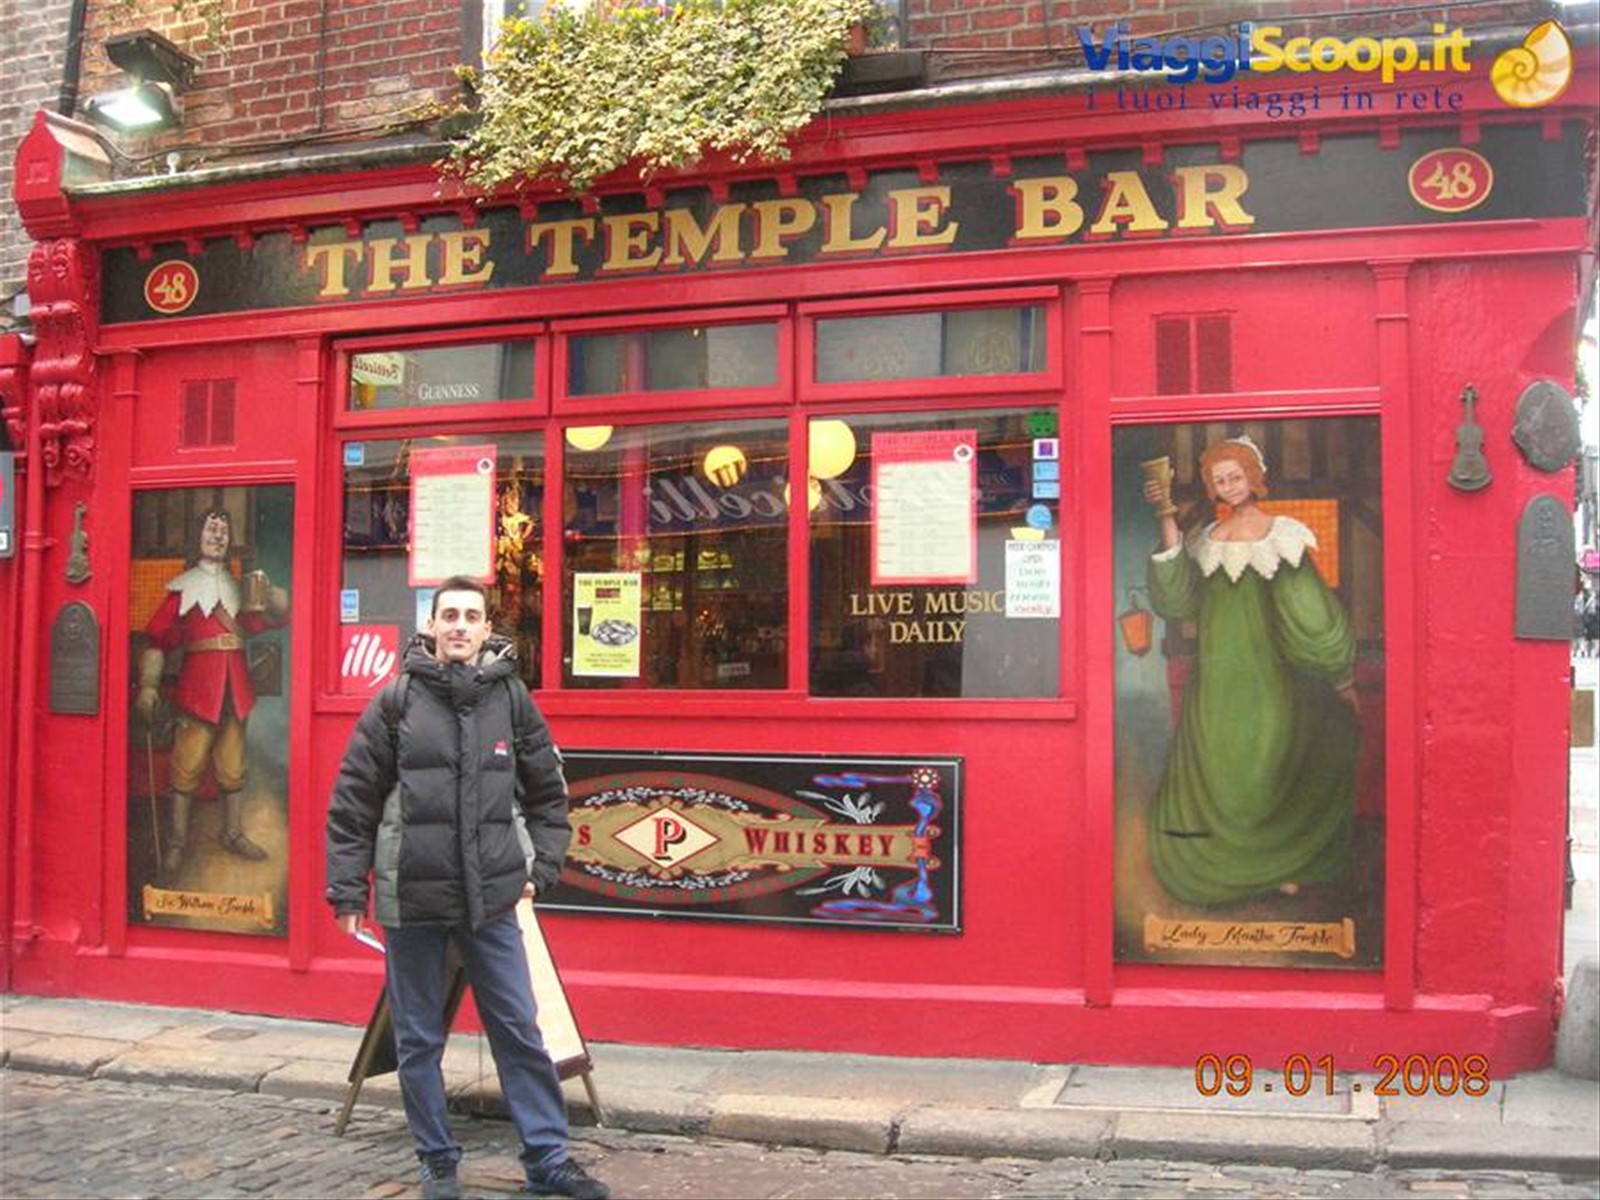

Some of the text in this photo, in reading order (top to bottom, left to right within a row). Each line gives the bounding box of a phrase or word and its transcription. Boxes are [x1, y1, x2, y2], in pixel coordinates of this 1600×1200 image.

[1421, 162, 1477, 200] 48
[304, 163, 1255, 299] THE TEMPLE BAR
[153, 272, 188, 305] 48
[850, 592, 914, 616] LIVE
[924, 590, 1006, 615] MUSIC
[889, 620, 967, 644] DAILY
[341, 633, 396, 688] illy
[743, 827, 896, 858] WHISKEY
[1162, 923, 1208, 945] Lady
